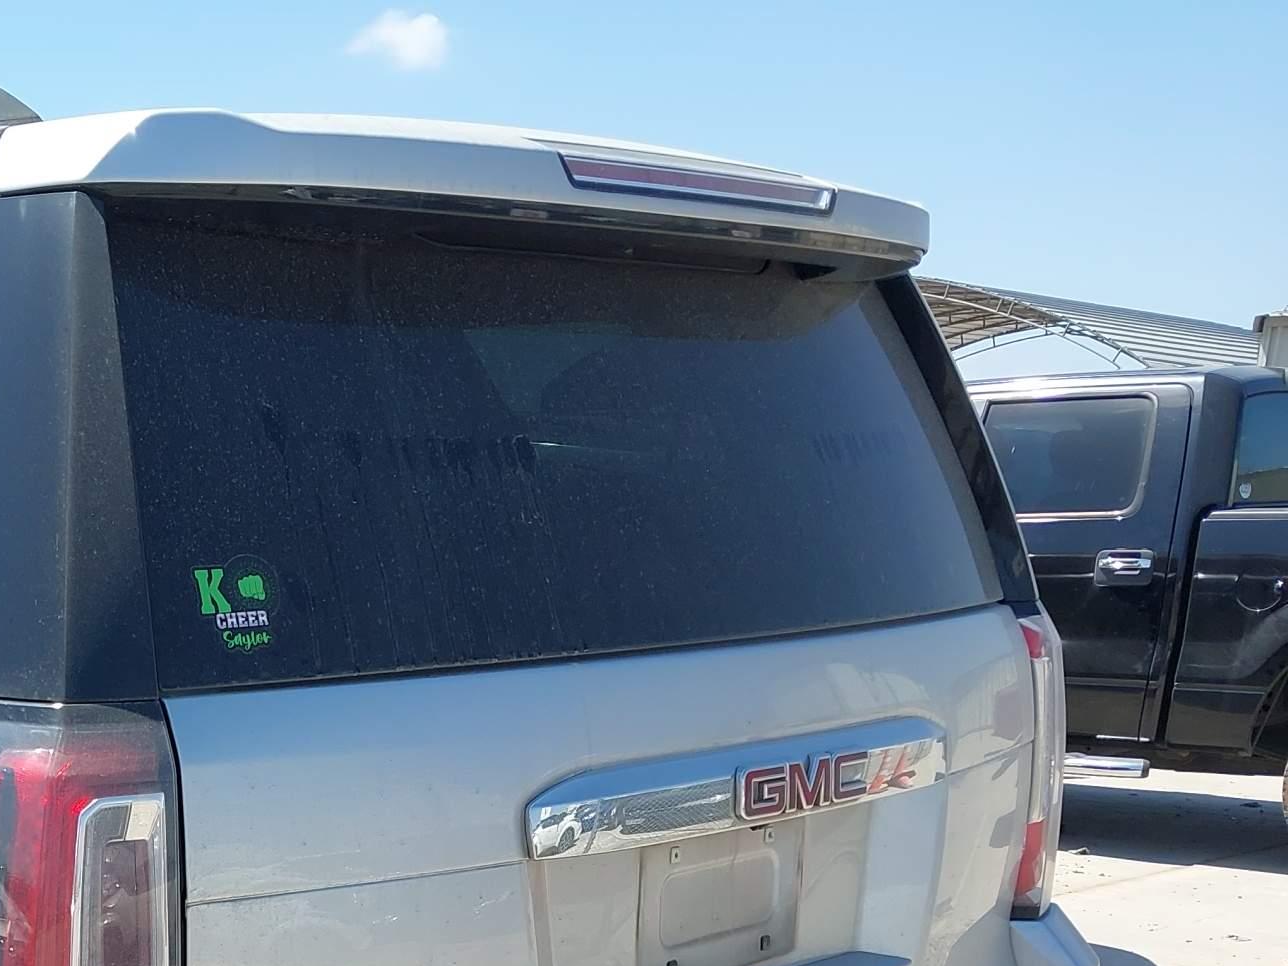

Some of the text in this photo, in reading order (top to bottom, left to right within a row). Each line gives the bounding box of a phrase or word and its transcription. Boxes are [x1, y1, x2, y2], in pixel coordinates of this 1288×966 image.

[194, 568, 232, 614] K
[215, 610, 269, 629] CHEER
[740, 751, 868, 820] GMC
